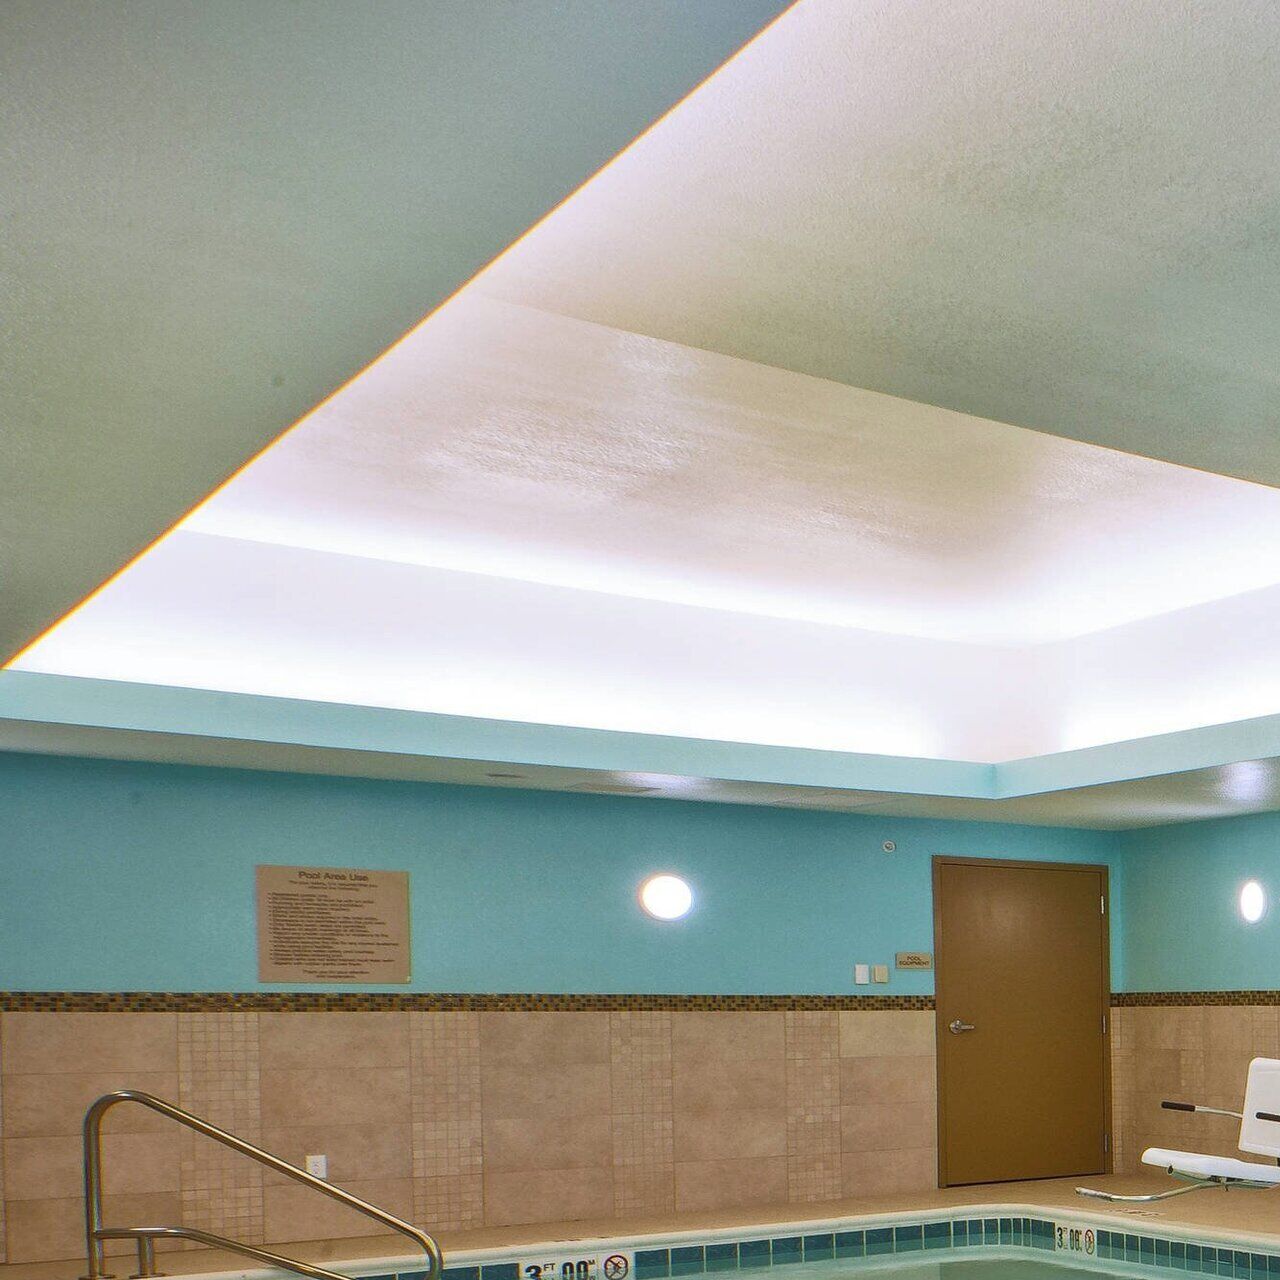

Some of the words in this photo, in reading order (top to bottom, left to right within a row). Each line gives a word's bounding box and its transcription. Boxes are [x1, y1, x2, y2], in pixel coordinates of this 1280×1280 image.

[299, 871, 321, 880] Pool
[323, 873, 346, 881] Area
[350, 874, 369, 882] Use
